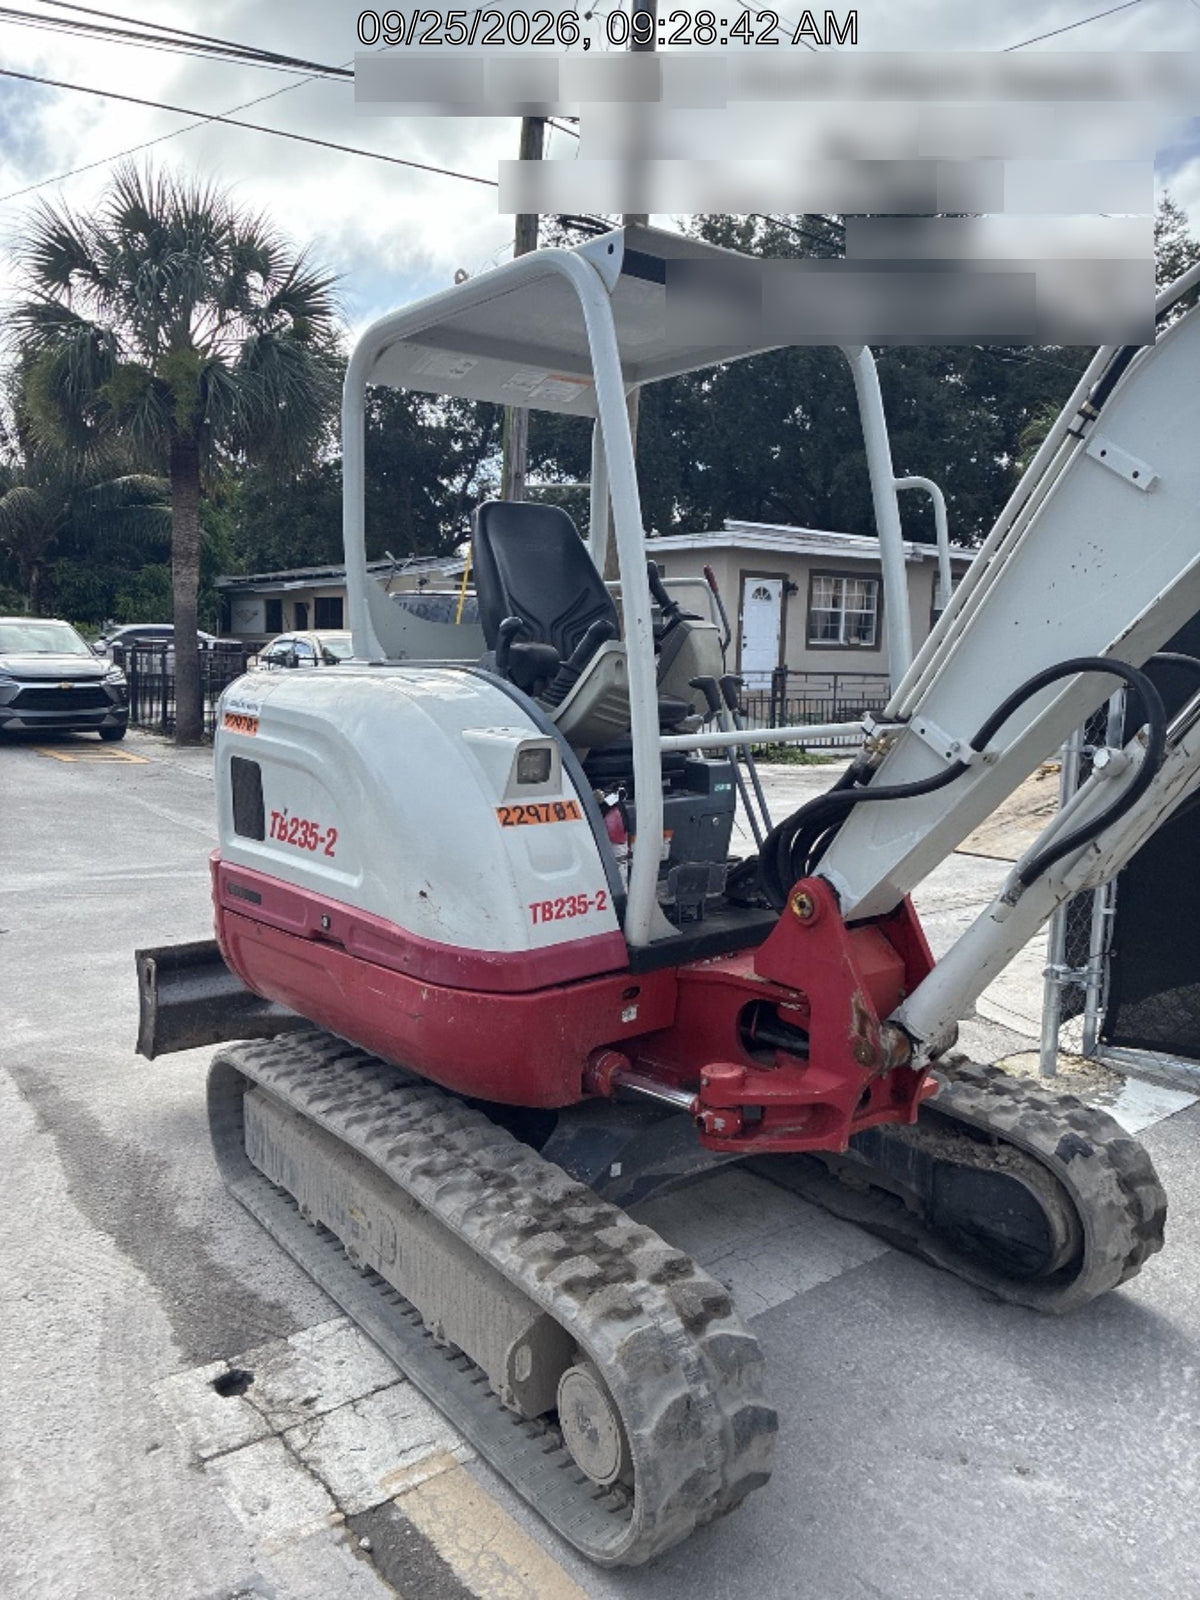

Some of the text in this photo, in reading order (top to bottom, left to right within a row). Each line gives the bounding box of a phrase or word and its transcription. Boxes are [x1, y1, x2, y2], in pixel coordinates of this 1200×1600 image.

[497, 801, 579, 826] 229701
[269, 811, 338, 857] TB235-2
[529, 890, 607, 924] TB235-2
